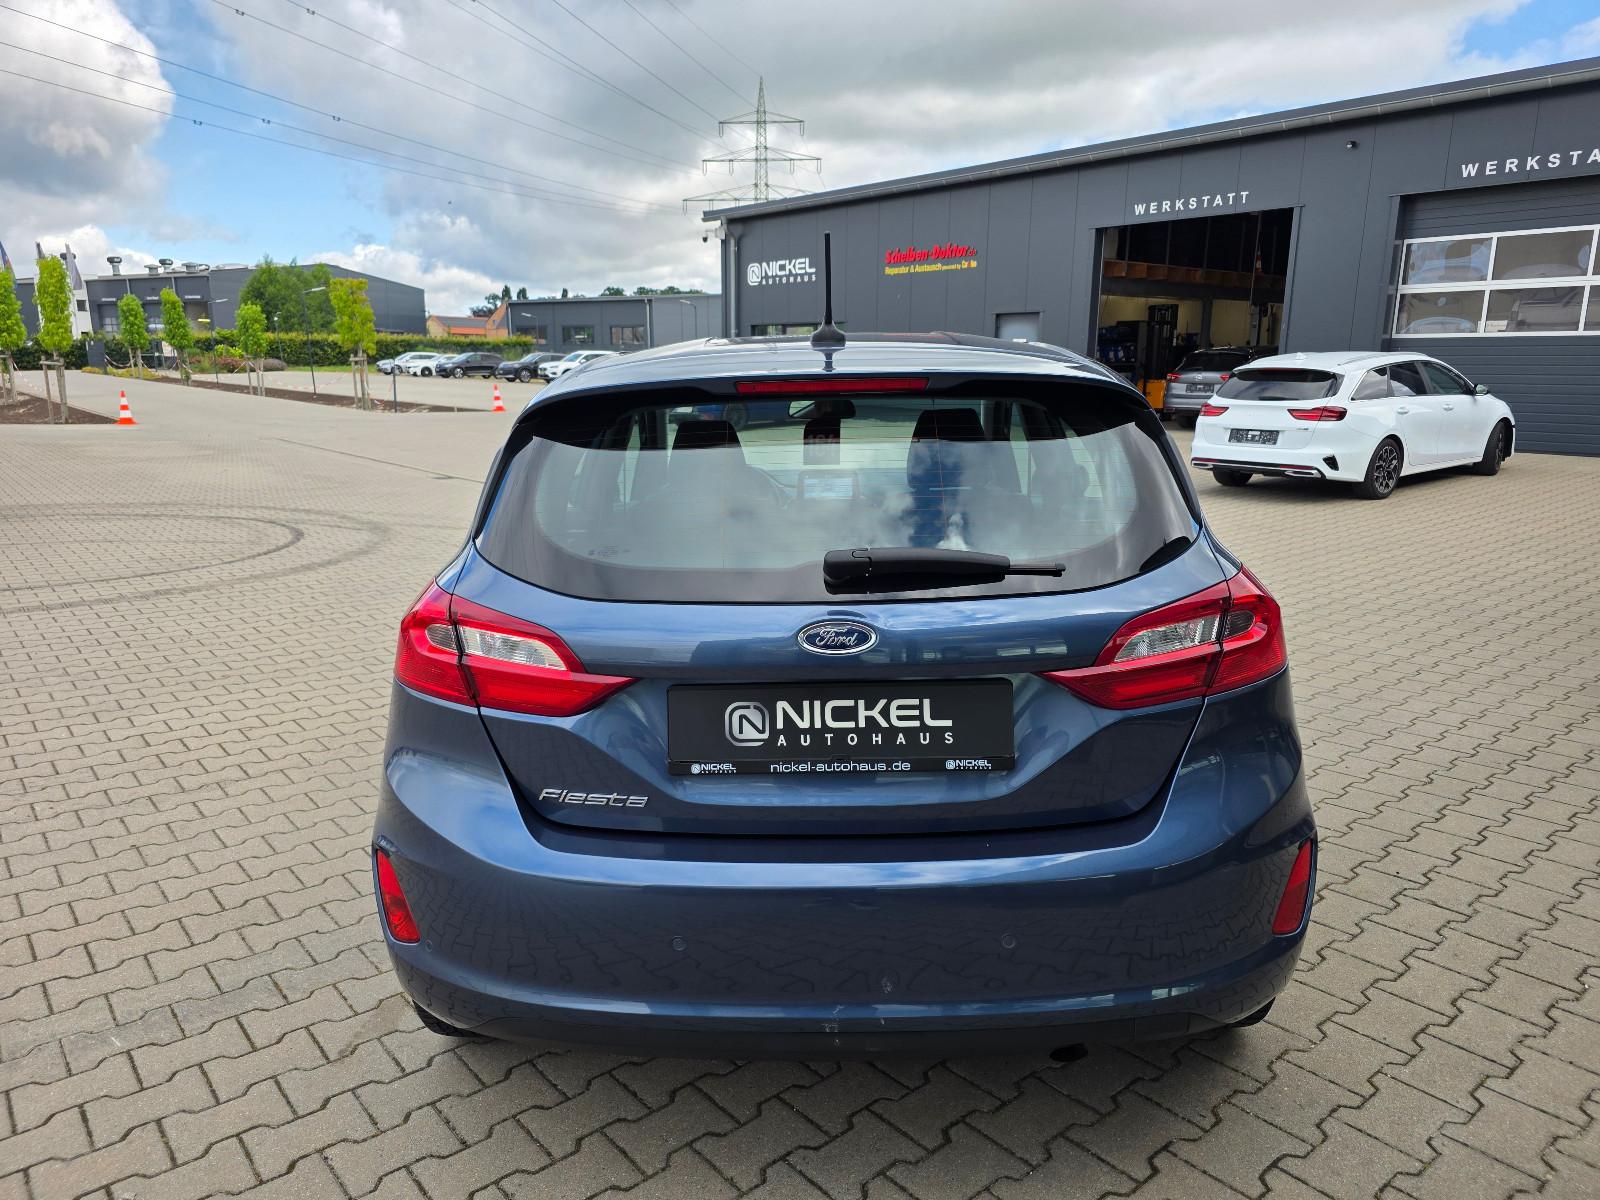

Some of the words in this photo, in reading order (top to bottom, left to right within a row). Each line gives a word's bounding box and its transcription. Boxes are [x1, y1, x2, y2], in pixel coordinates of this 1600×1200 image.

[1461, 148, 1600, 178] WERKSTA
[1134, 191, 1249, 216] WERKSTATT
[761, 257, 816, 277] NICKEL
[761, 274, 816, 285] AUTOHAUS
[815, 627, 858, 646] Ford
[776, 698, 953, 730] NICKEL
[777, 732, 954, 747] AUTOHAUS
[701, 763, 737, 771] NICKEL
[770, 760, 911, 773] nickel-autohaus.de
[955, 759, 992, 767] NICKEL
[538, 788, 649, 808] Fiesta
